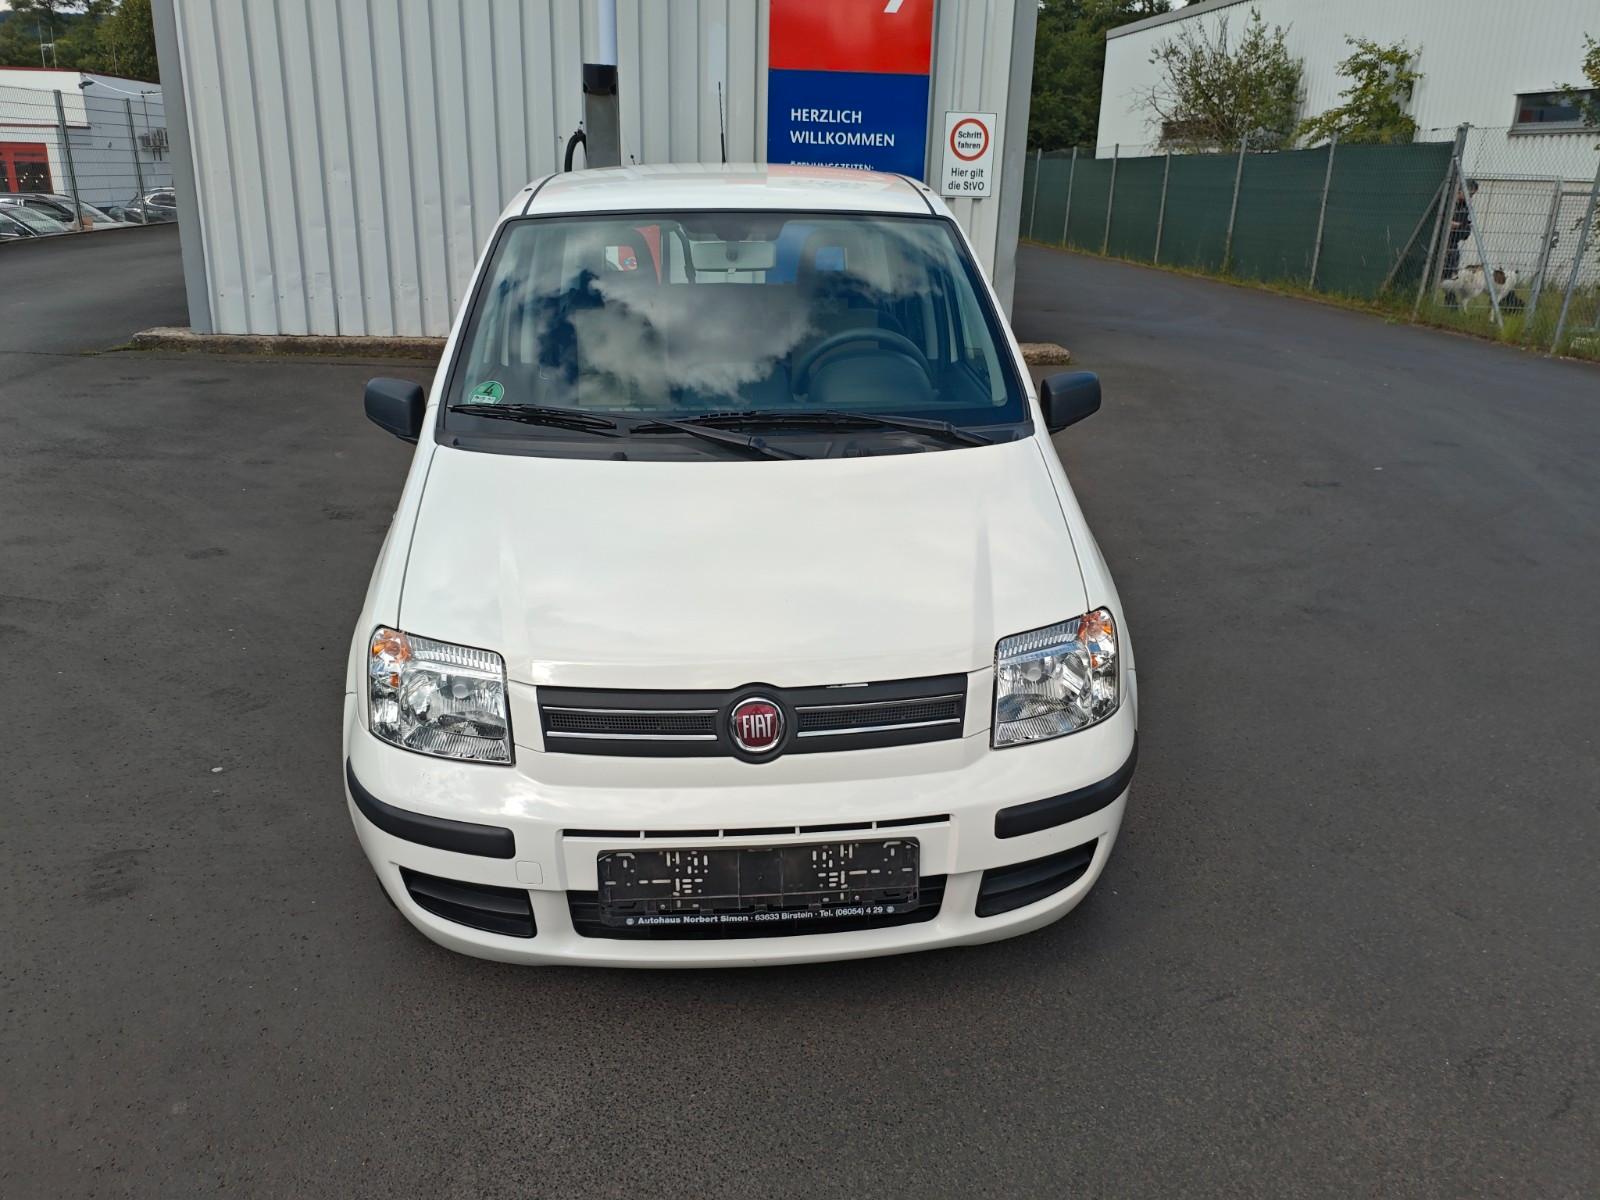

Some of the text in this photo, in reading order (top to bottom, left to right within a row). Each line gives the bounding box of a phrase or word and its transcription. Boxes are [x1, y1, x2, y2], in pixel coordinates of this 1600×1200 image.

[790, 108, 862, 124] HERZLICH
[790, 130, 895, 147] WILLKOMMEN
[958, 130, 982, 139] Schritt
[958, 141, 981, 149] fahren
[951, 167, 984, 179] Hier gilt
[948, 180, 985, 191] die StVO
[483, 383, 495, 396] 4
[742, 713, 774, 739] FIAT
[683, 915, 718, 924] Norbert
[720, 914, 749, 923] Simon
[755, 913, 780, 921] 63633
[781, 911, 813, 920] Birstein
[820, 909, 833, 917] Tel.
[836, 907, 864, 916] (06054)
[865, 906, 872, 914] 4
[873, 906, 883, 914] 29
